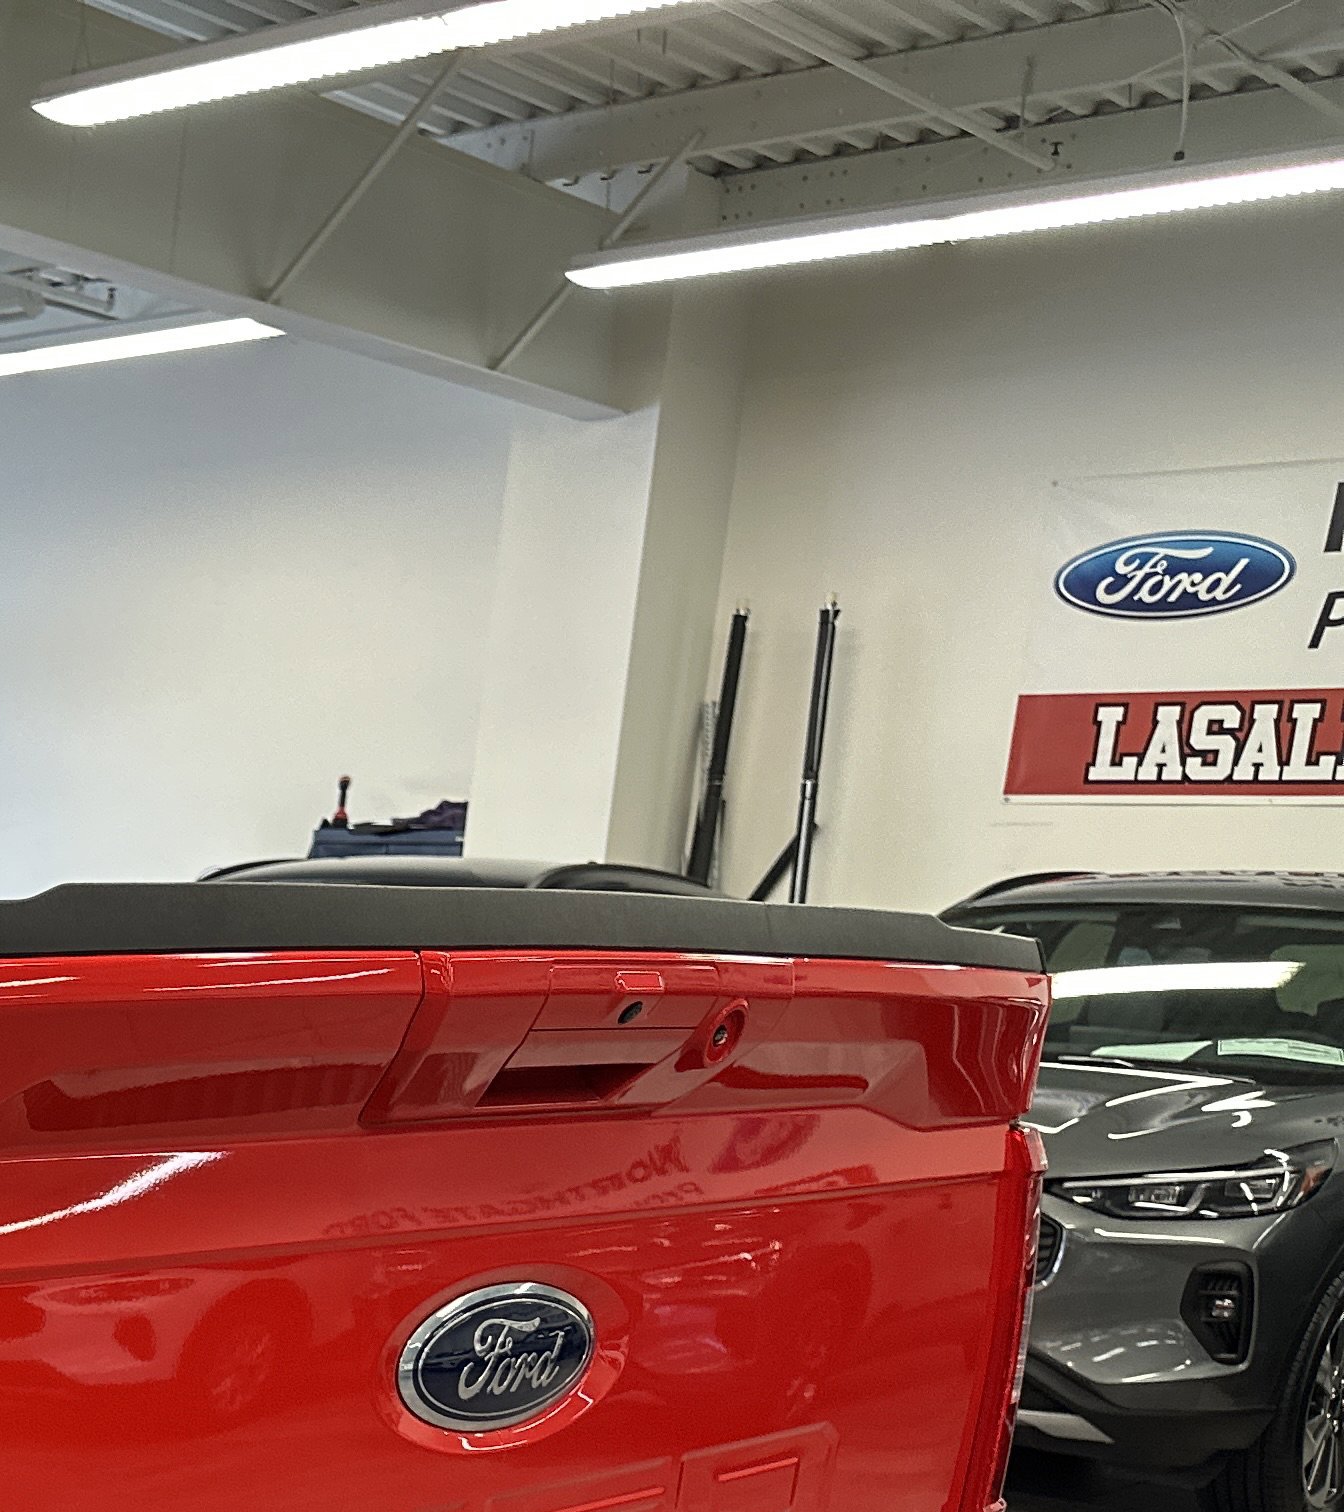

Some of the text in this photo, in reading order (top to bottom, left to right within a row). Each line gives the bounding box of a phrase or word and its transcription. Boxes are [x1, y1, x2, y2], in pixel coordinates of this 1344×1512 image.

[1095, 546, 1251, 605] Ford
[1083, 699, 1344, 784] LASAL
[457, 1316, 565, 1400] Ford
